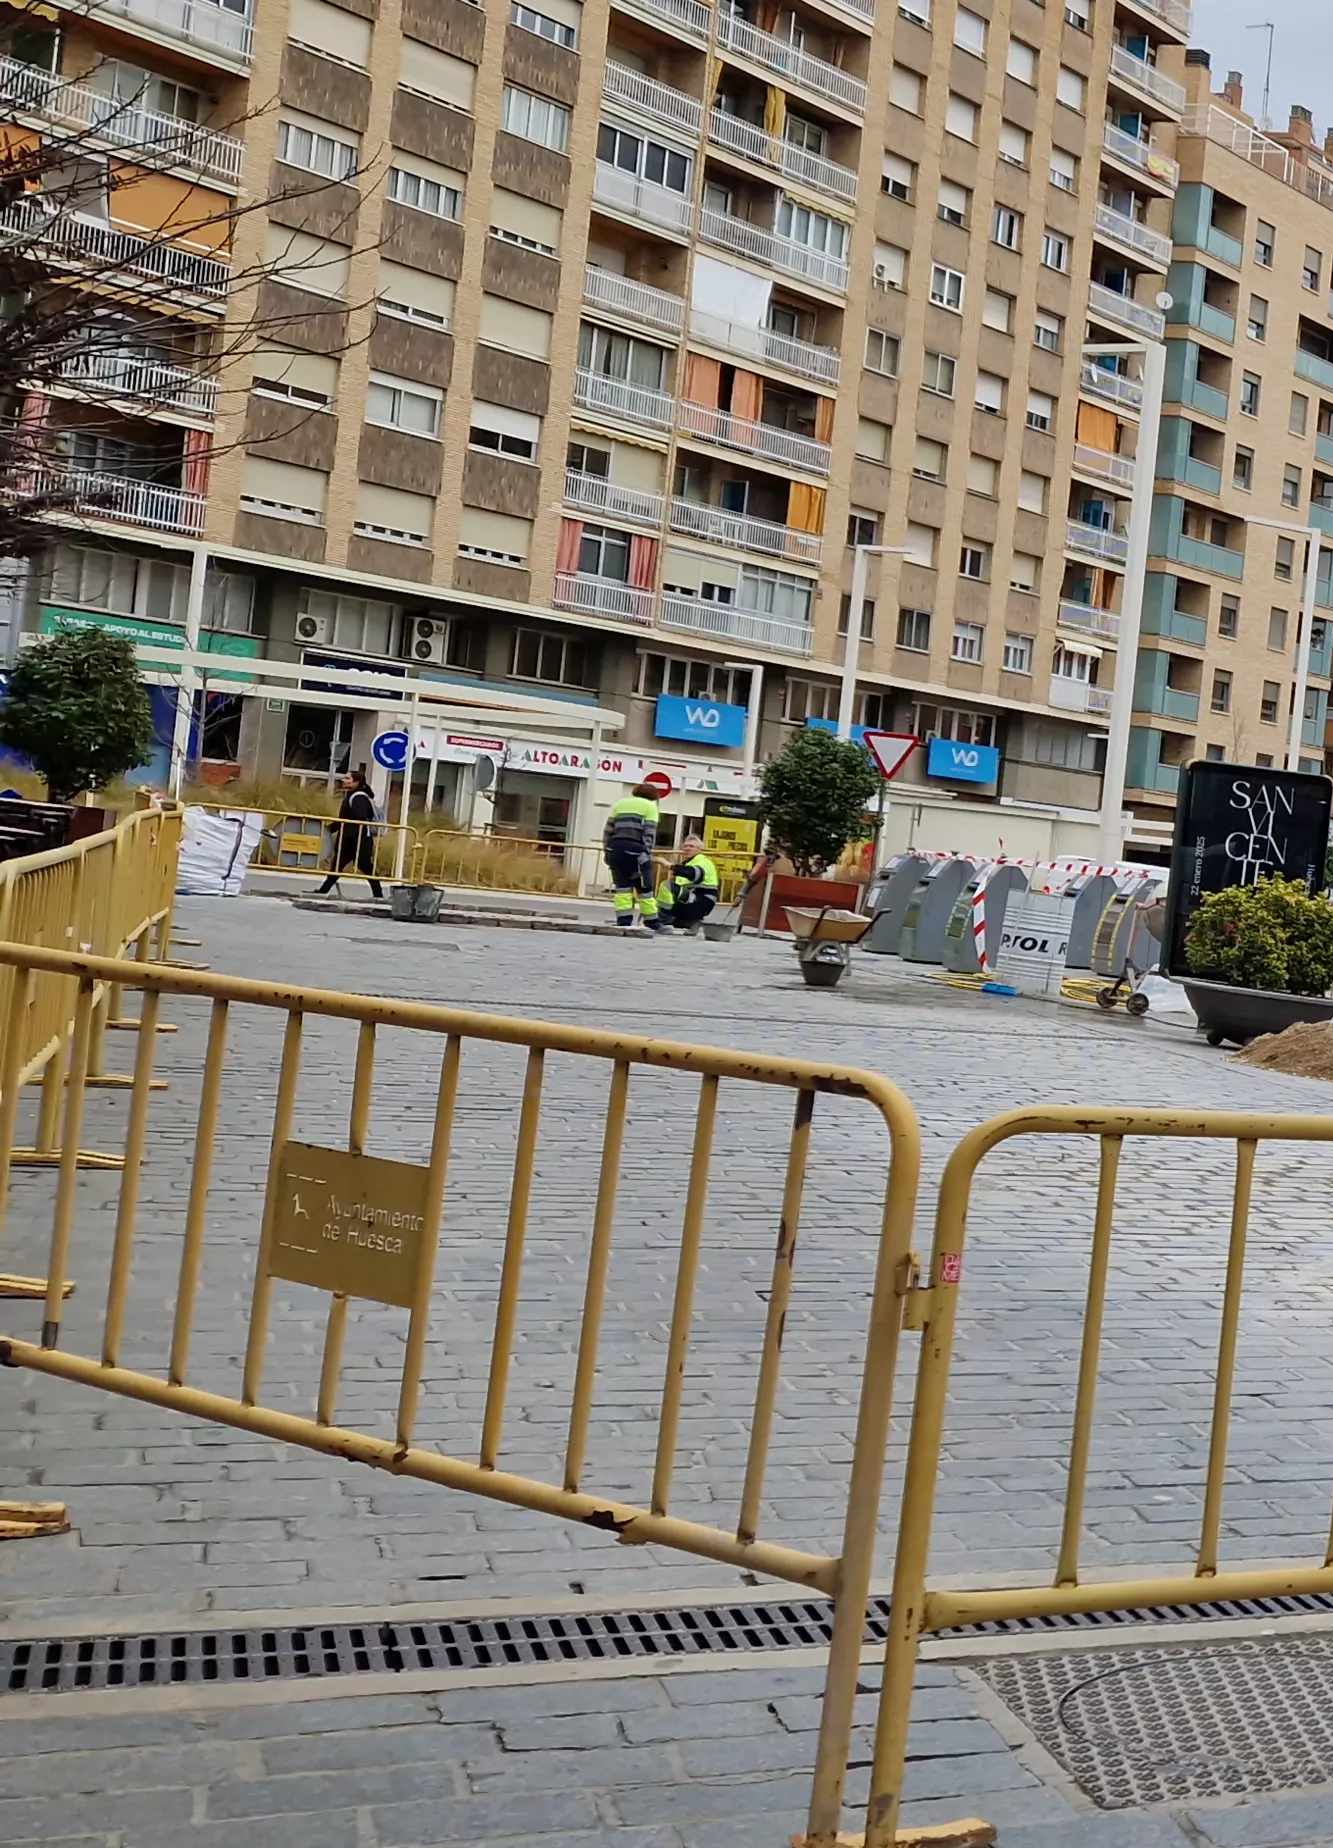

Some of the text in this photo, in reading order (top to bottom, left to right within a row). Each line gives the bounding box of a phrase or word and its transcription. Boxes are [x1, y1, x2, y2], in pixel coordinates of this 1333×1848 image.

[1229, 780, 1295, 815] SAN
[1225, 831, 1288, 865] CEN
[1190, 836, 1206, 896] 22 enero 2025
[326, 1194, 425, 1232] Ayuntamiento
[322, 1223, 403, 1254] de Huesca
